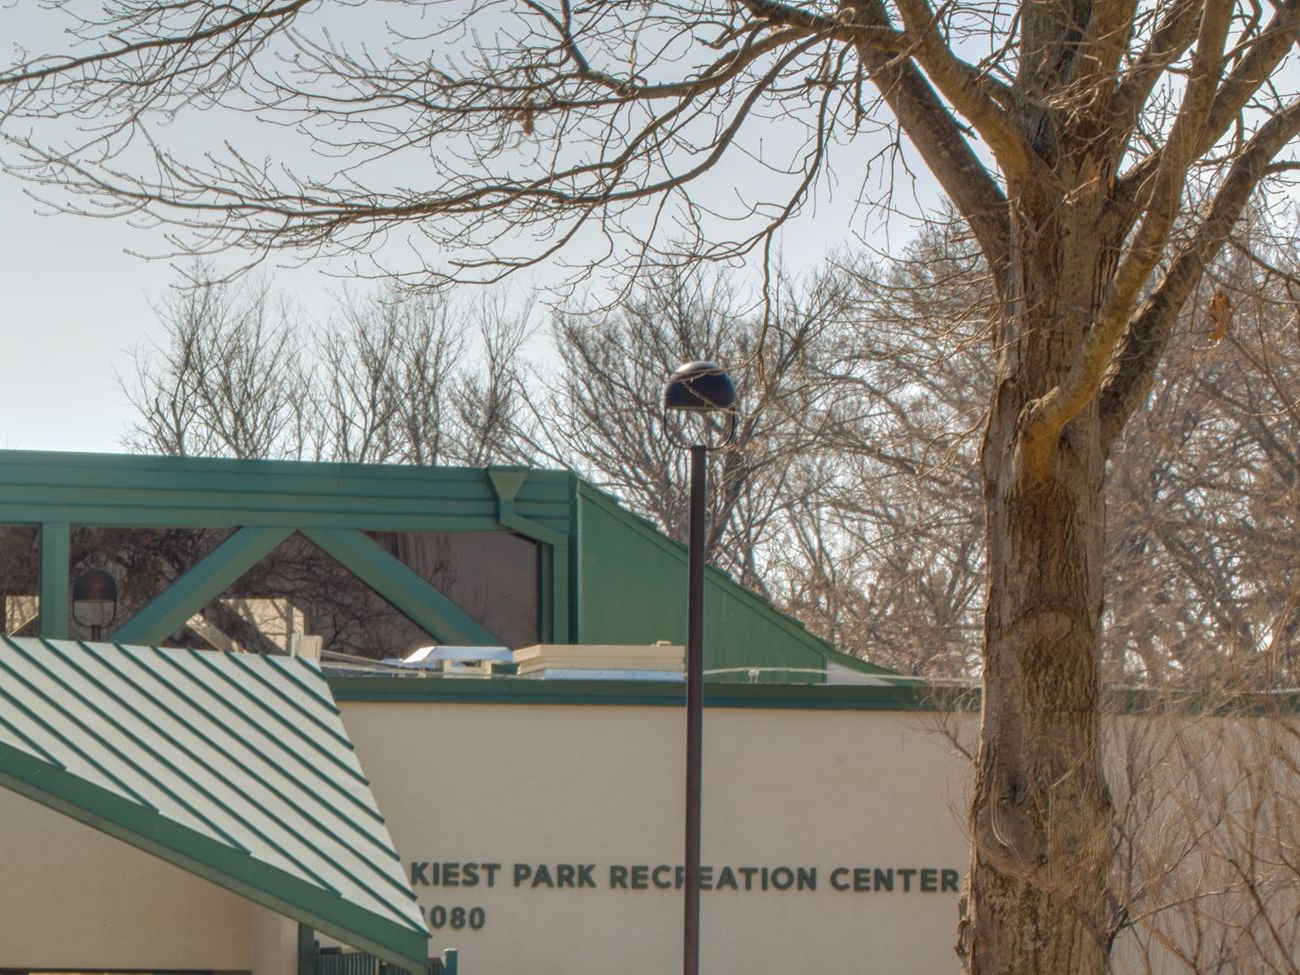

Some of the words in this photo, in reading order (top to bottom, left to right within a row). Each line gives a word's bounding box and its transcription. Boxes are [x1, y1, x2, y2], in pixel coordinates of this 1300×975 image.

[410, 862, 501, 887] KIEST
[514, 864, 597, 888] PARK
[830, 867, 959, 892] CENTER
